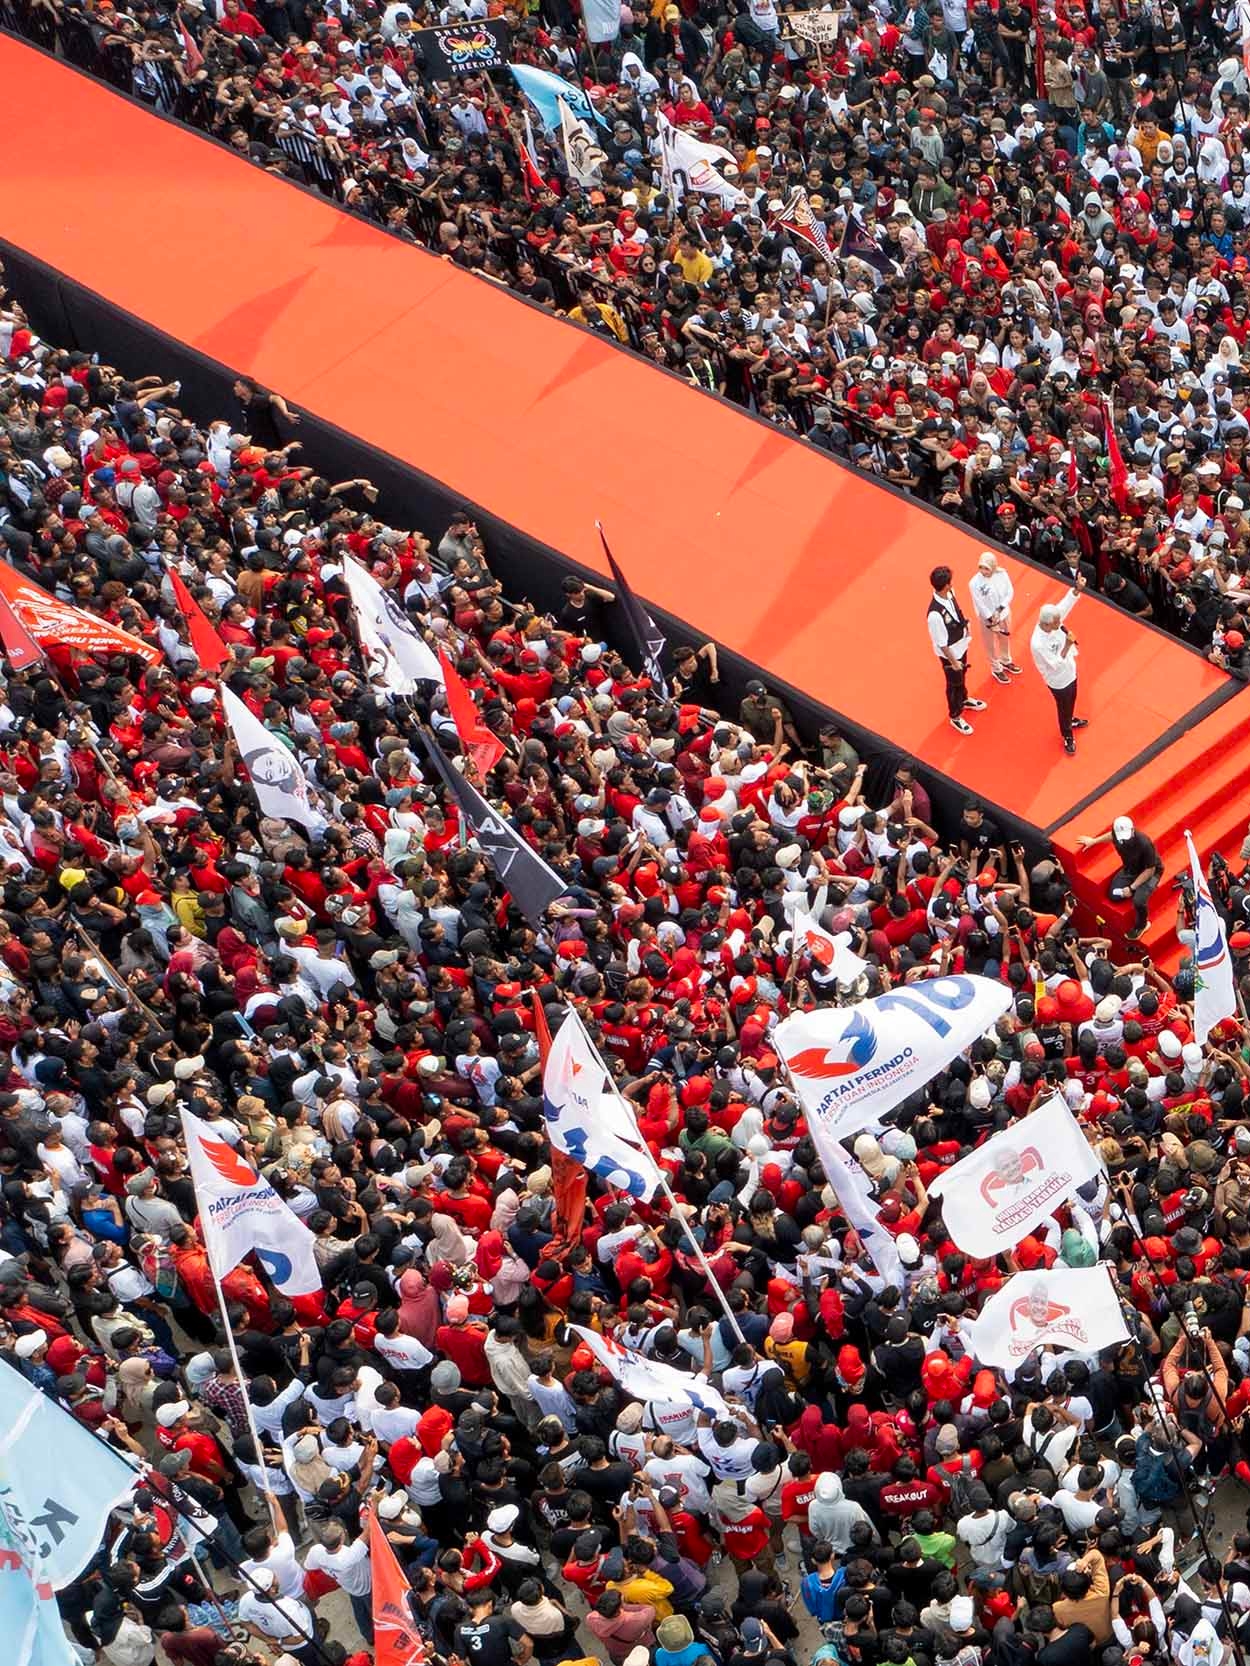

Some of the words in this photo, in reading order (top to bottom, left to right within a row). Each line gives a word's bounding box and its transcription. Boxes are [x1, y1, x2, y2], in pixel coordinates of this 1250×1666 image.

[854, 1045, 914, 1085] PERINDO
[866, 1055, 919, 1088] INDONESIA
[471, 1635, 483, 1650] 3
